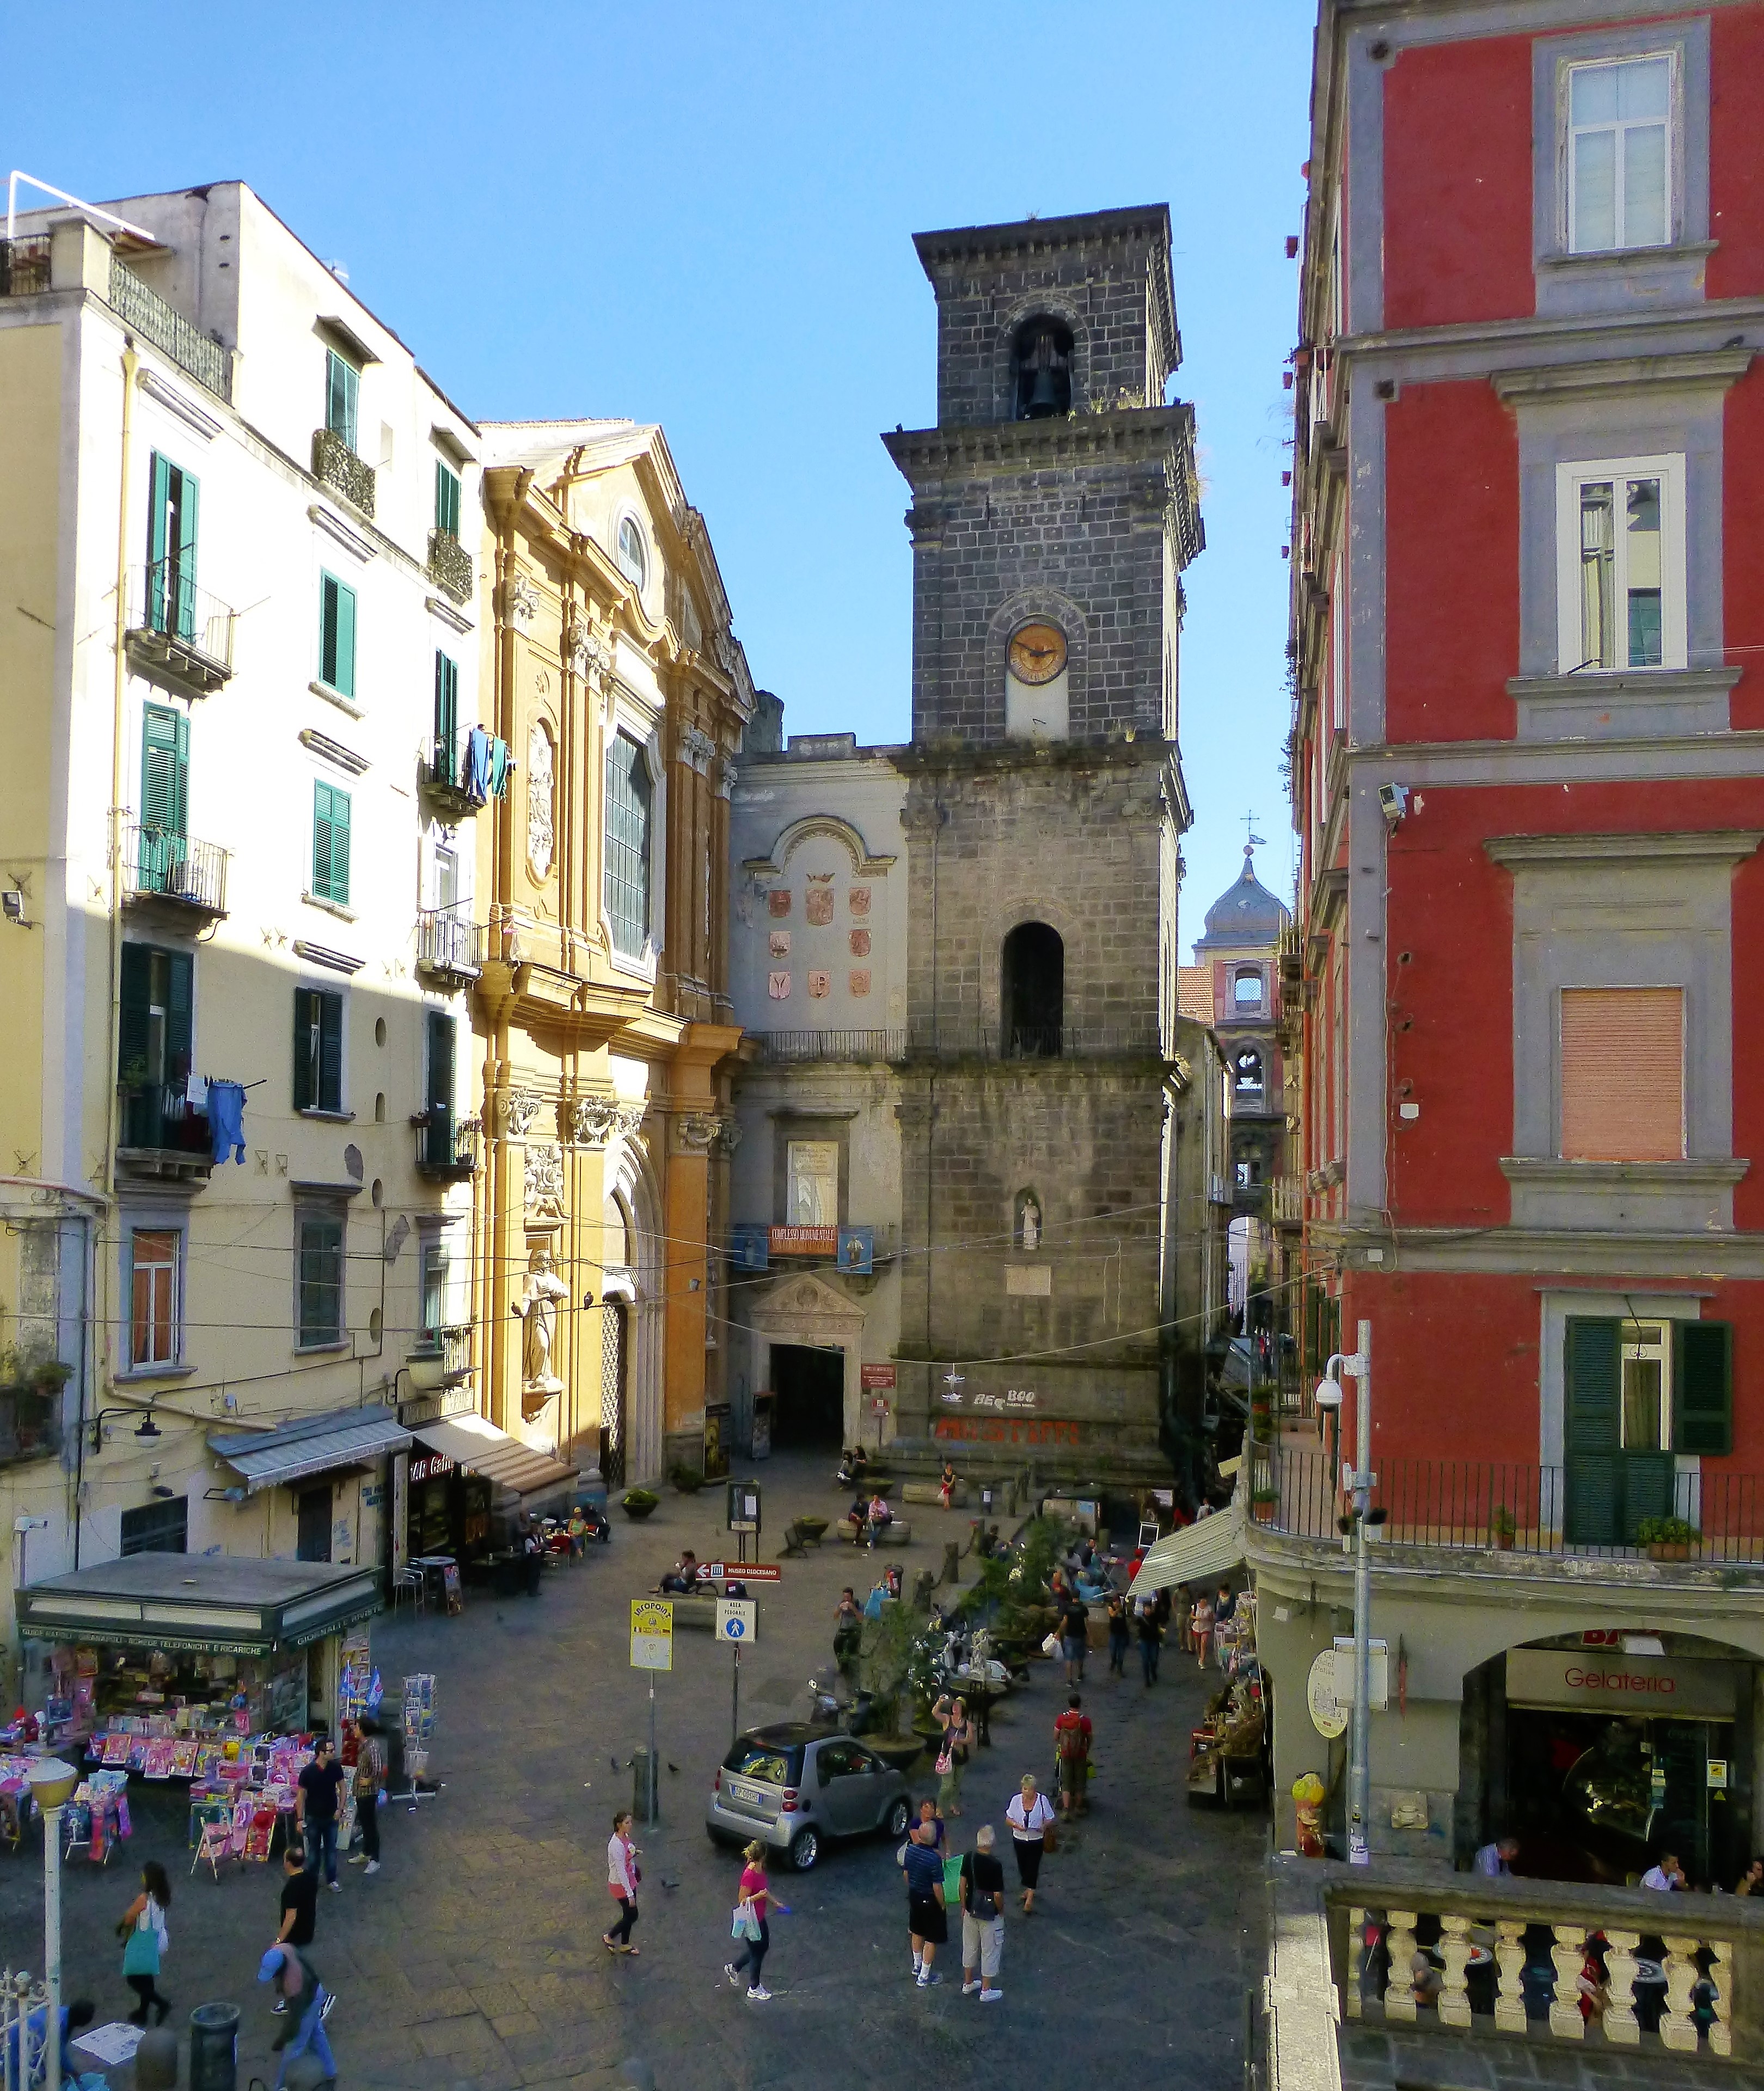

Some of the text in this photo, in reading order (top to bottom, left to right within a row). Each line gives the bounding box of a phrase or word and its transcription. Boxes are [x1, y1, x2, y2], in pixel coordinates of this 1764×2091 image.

[772, 1228, 835, 1241] COMPLESSO MONUMENTALE
[160, 1639, 210, 1651] TELEFONICHE
[220, 1644, 262, 1655] RICARICHE
[1564, 1668, 1676, 1692] Gelateria
